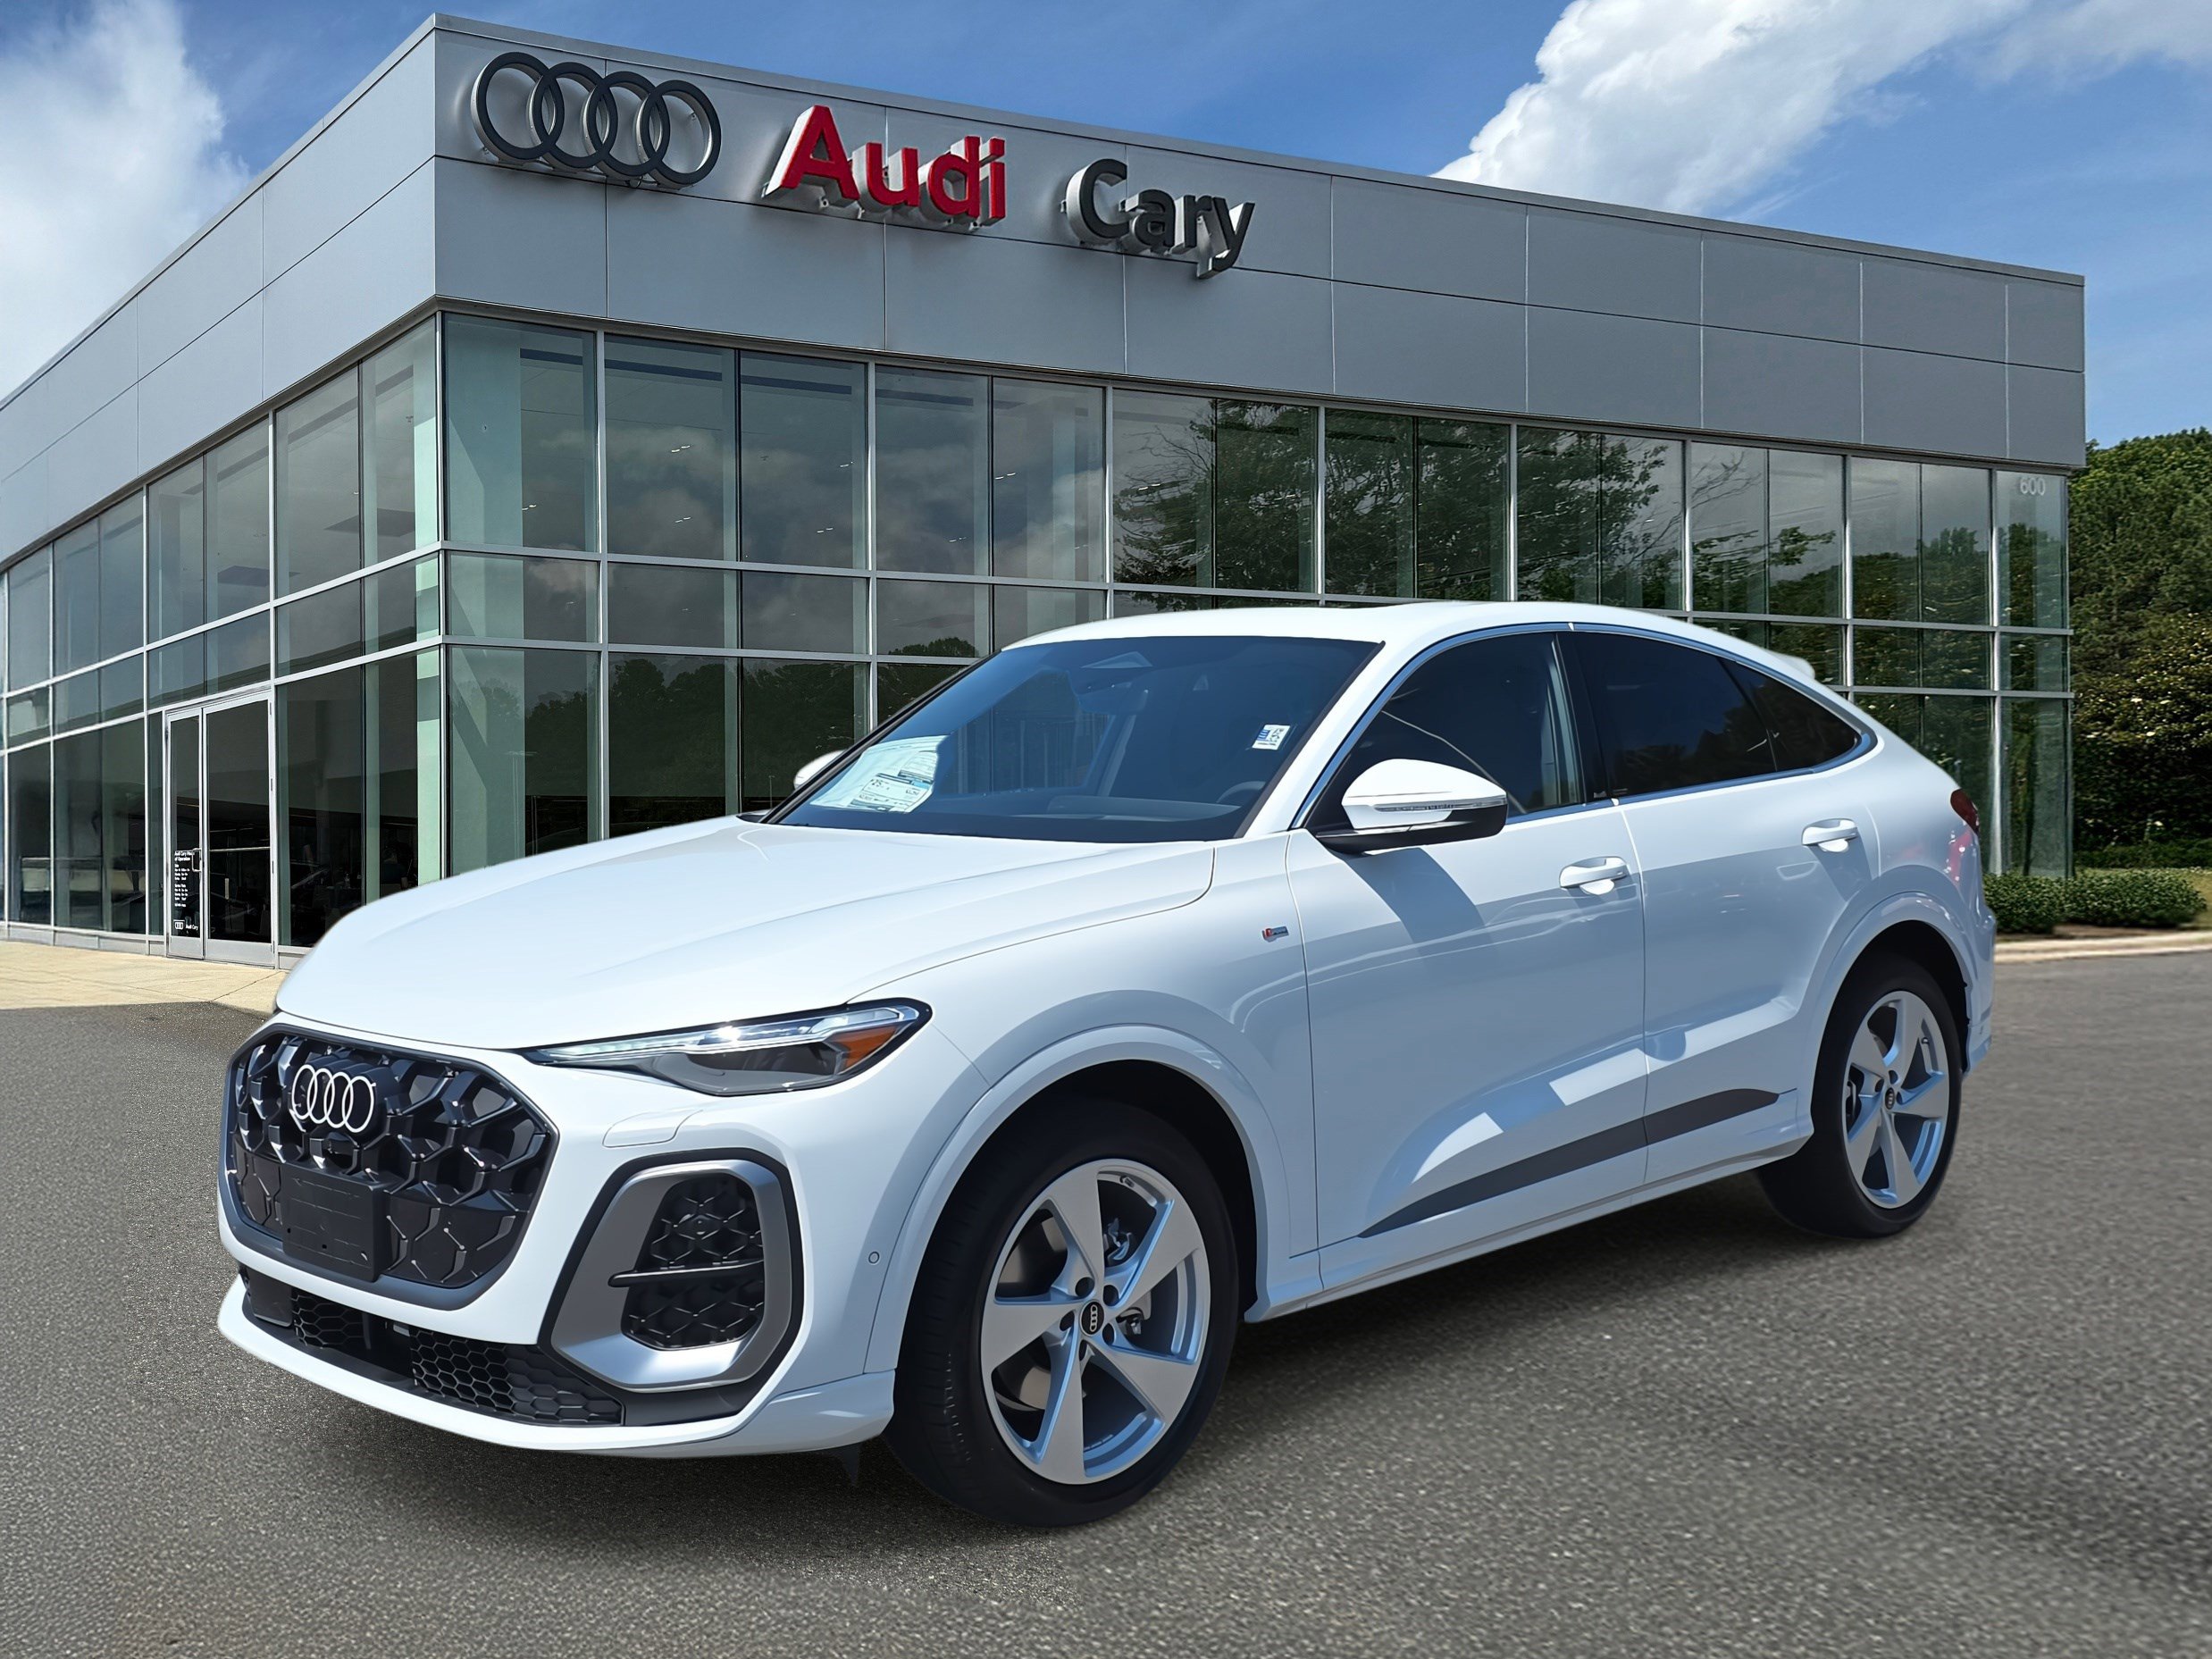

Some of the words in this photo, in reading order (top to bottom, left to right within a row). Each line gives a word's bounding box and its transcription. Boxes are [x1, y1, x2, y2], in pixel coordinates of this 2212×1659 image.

[768, 105, 1005, 228] Audi
[1067, 158, 1255, 278] Cary
[2020, 476, 2046, 496] 600
